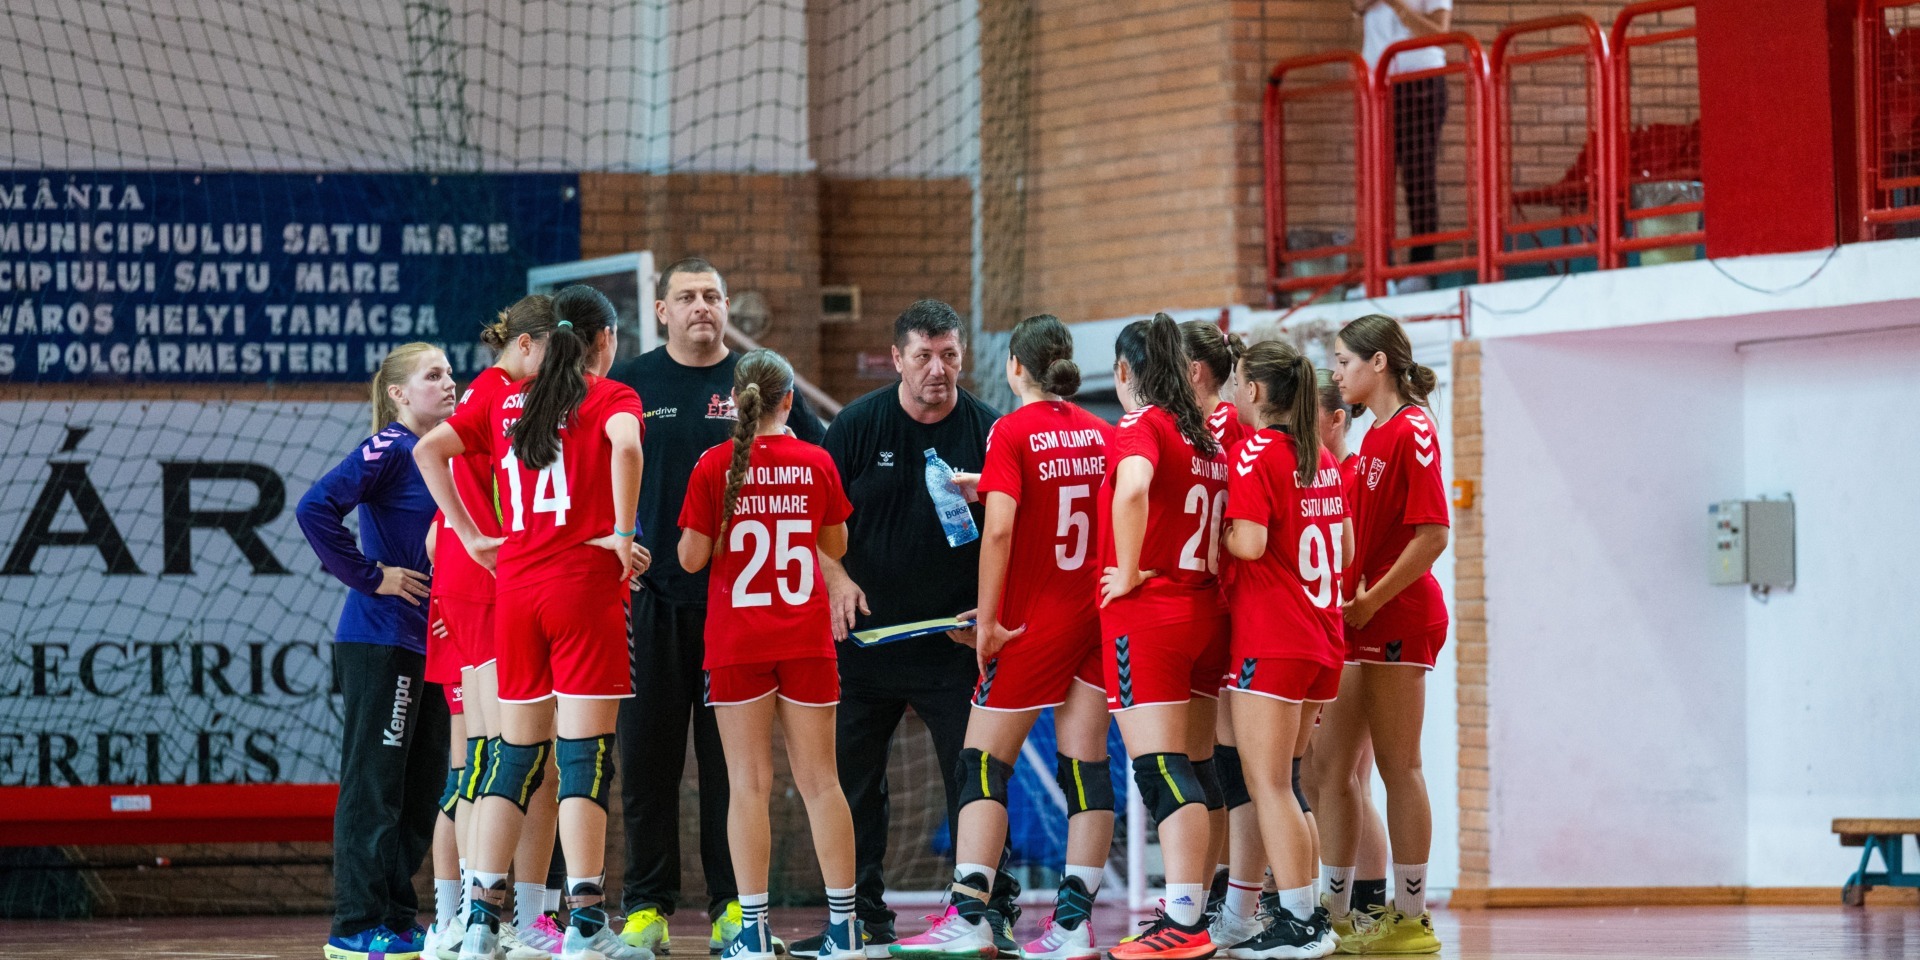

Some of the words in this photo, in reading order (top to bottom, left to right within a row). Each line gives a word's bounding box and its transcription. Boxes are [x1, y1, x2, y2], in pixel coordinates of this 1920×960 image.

[0, 222, 263, 254] MUNICIPIULUI
[283, 223, 381, 254] SATU
[402, 224, 510, 254] MARE
[0, 261, 156, 293] CIPIULUI
[174, 262, 270, 293] SATU
[295, 262, 400, 293] MARE
[135, 304, 246, 335] HELYI
[265, 299, 439, 336] TANÁCSA
[38, 337, 348, 374] POLGÁRMESTERI
[1029, 431, 1059, 453] CSM
[1059, 428, 1106, 448] OLIMPIA
[756, 466, 814, 485] OLIMPIA
[1038, 458, 1071, 481] SATU
[1072, 456, 1106, 476] MARE
[1191, 456, 1210, 478] SATU
[501, 438, 571, 532] 14
[733, 495, 767, 515] SATU
[768, 495, 809, 514] MARE
[1300, 498, 1321, 517] SATU
[1055, 484, 1090, 571] 5
[729, 519, 814, 608] 25
[382, 674, 413, 748] Kempa
